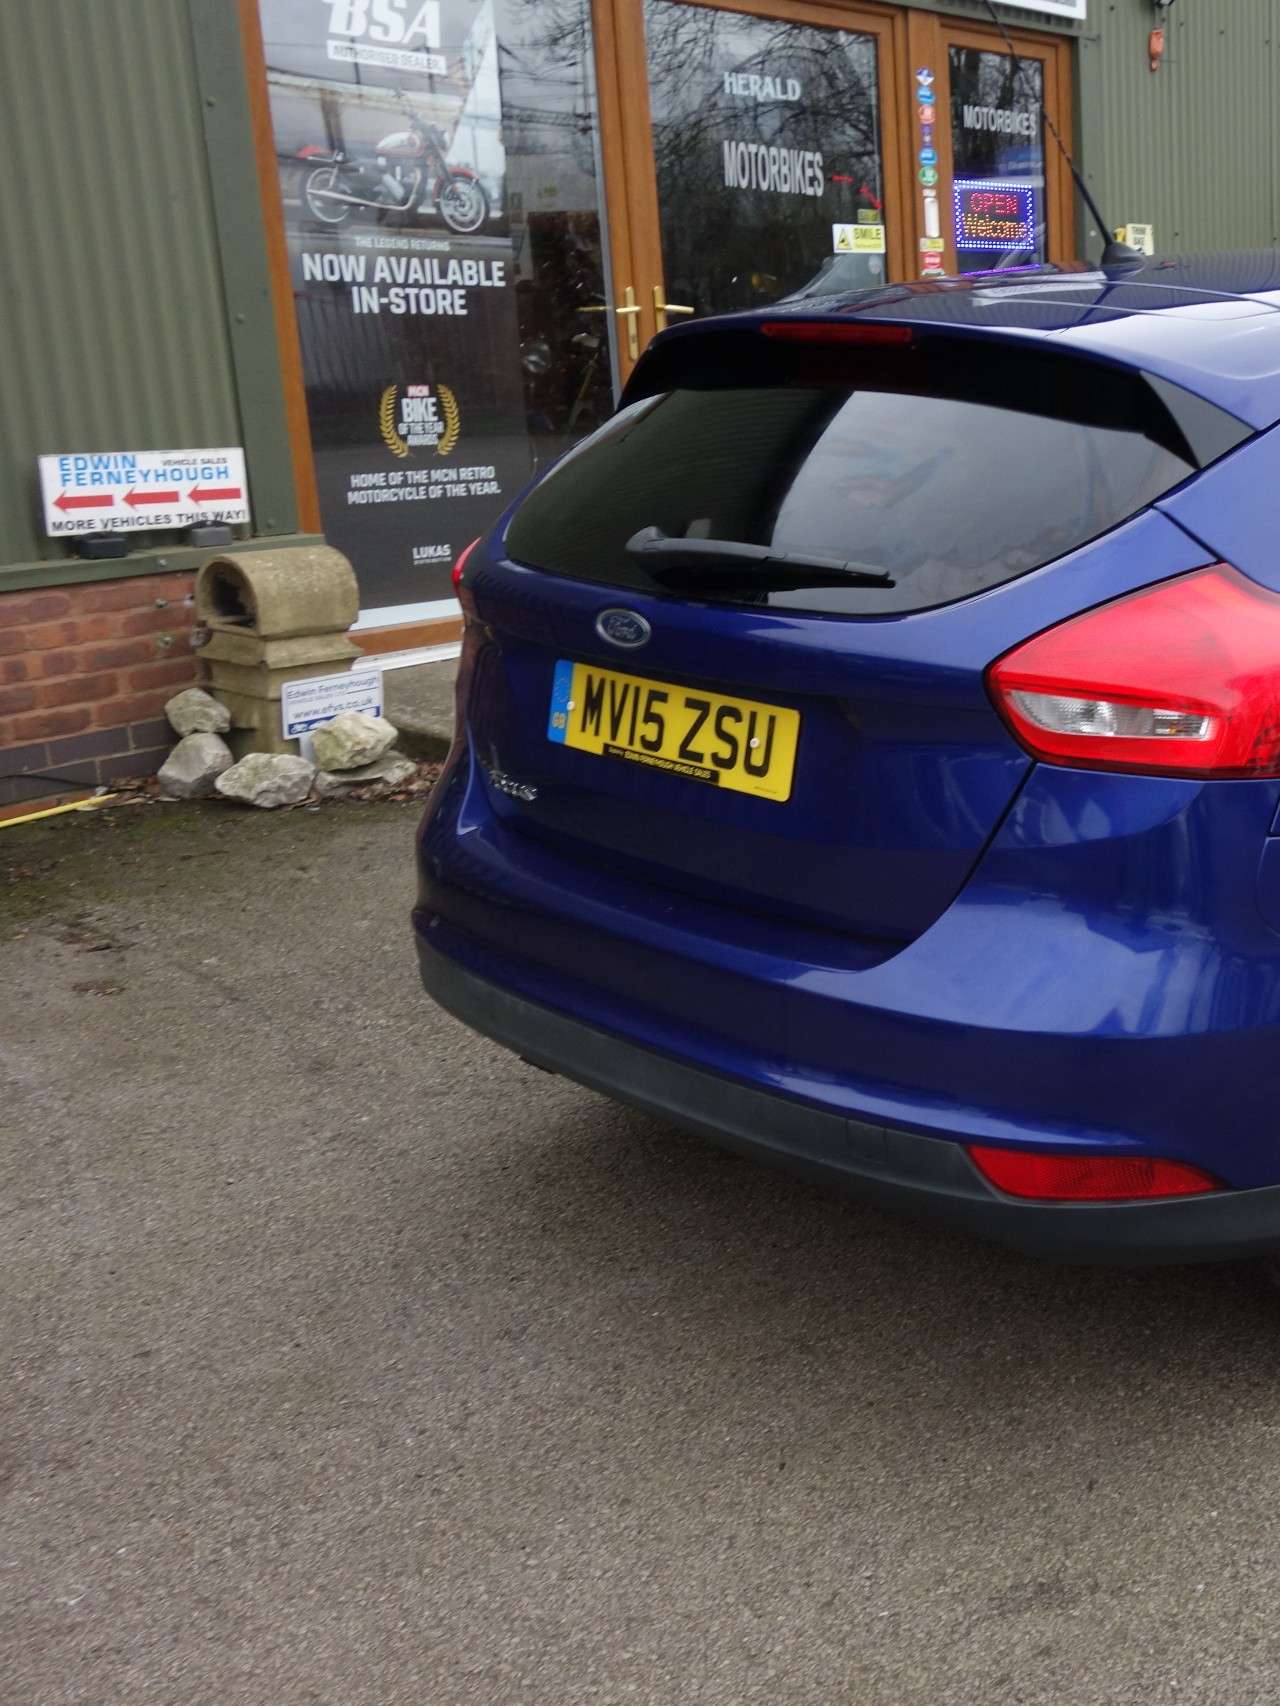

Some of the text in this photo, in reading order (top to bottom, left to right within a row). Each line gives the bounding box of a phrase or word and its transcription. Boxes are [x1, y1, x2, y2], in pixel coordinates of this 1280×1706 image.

[321, 0, 441, 48] BSA
[723, 72, 801, 101] HERALD
[963, 104, 1037, 136] MOTORBIKES
[723, 140, 824, 197] MOTORBIKES
[971, 192, 1017, 215] OPEN
[854, 228, 881, 240] SMILE
[961, 213, 1028, 238] Welcome
[355, 236, 373, 248] THE
[302, 253, 506, 287] NOW AVAILABLE
[351, 286, 468, 315] IN-STORE
[401, 397, 438, 423] BIKE
[59, 454, 227, 472] EDWIN VEHICLE SALES
[61, 466, 229, 487] FERNEYHOUGH
[351, 466, 495, 488] HOME OF THE MCN RETRO
[347, 481, 502, 505] MOTORCYCLE OF THE YEAR.
[52, 508, 246, 532] MORE VEHICLES THIS WAY!
[412, 544, 451, 559] LUKAS
[580, 674, 776, 778] MV15 ZSU
